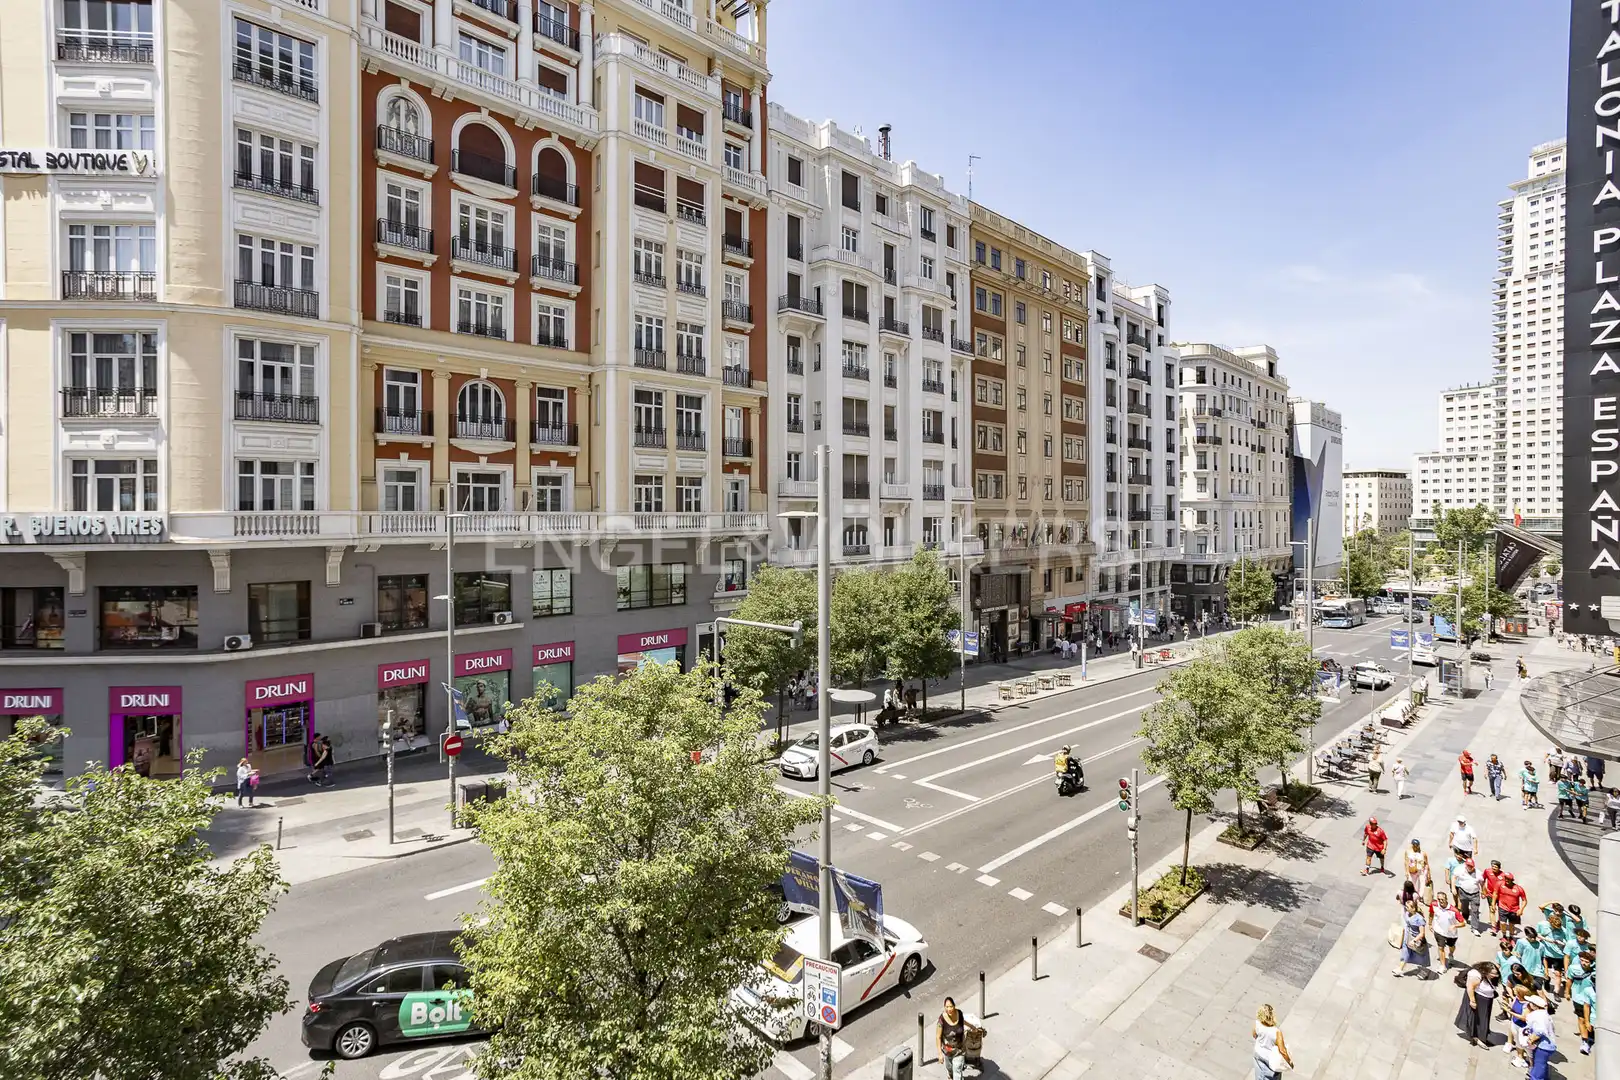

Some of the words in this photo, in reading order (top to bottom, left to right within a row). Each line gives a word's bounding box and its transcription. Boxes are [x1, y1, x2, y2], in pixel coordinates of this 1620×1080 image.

[46, 152, 128, 171] BOUTIQUE
[1588, 397, 1620, 570] ESPAÑA
[30, 516, 105, 536] BUENOS
[109, 516, 163, 536] AIRES
[641, 634, 668, 647] DRUNI
[538, 646, 571, 661] DRUNI
[465, 655, 502, 671] DRUNI
[383, 666, 426, 682] DRUNI
[255, 681, 306, 700] DRUNI
[4, 695, 52, 709] DRUNI
[121, 694, 169, 708] DRUNI
[410, 1000, 462, 1027] Bolt
